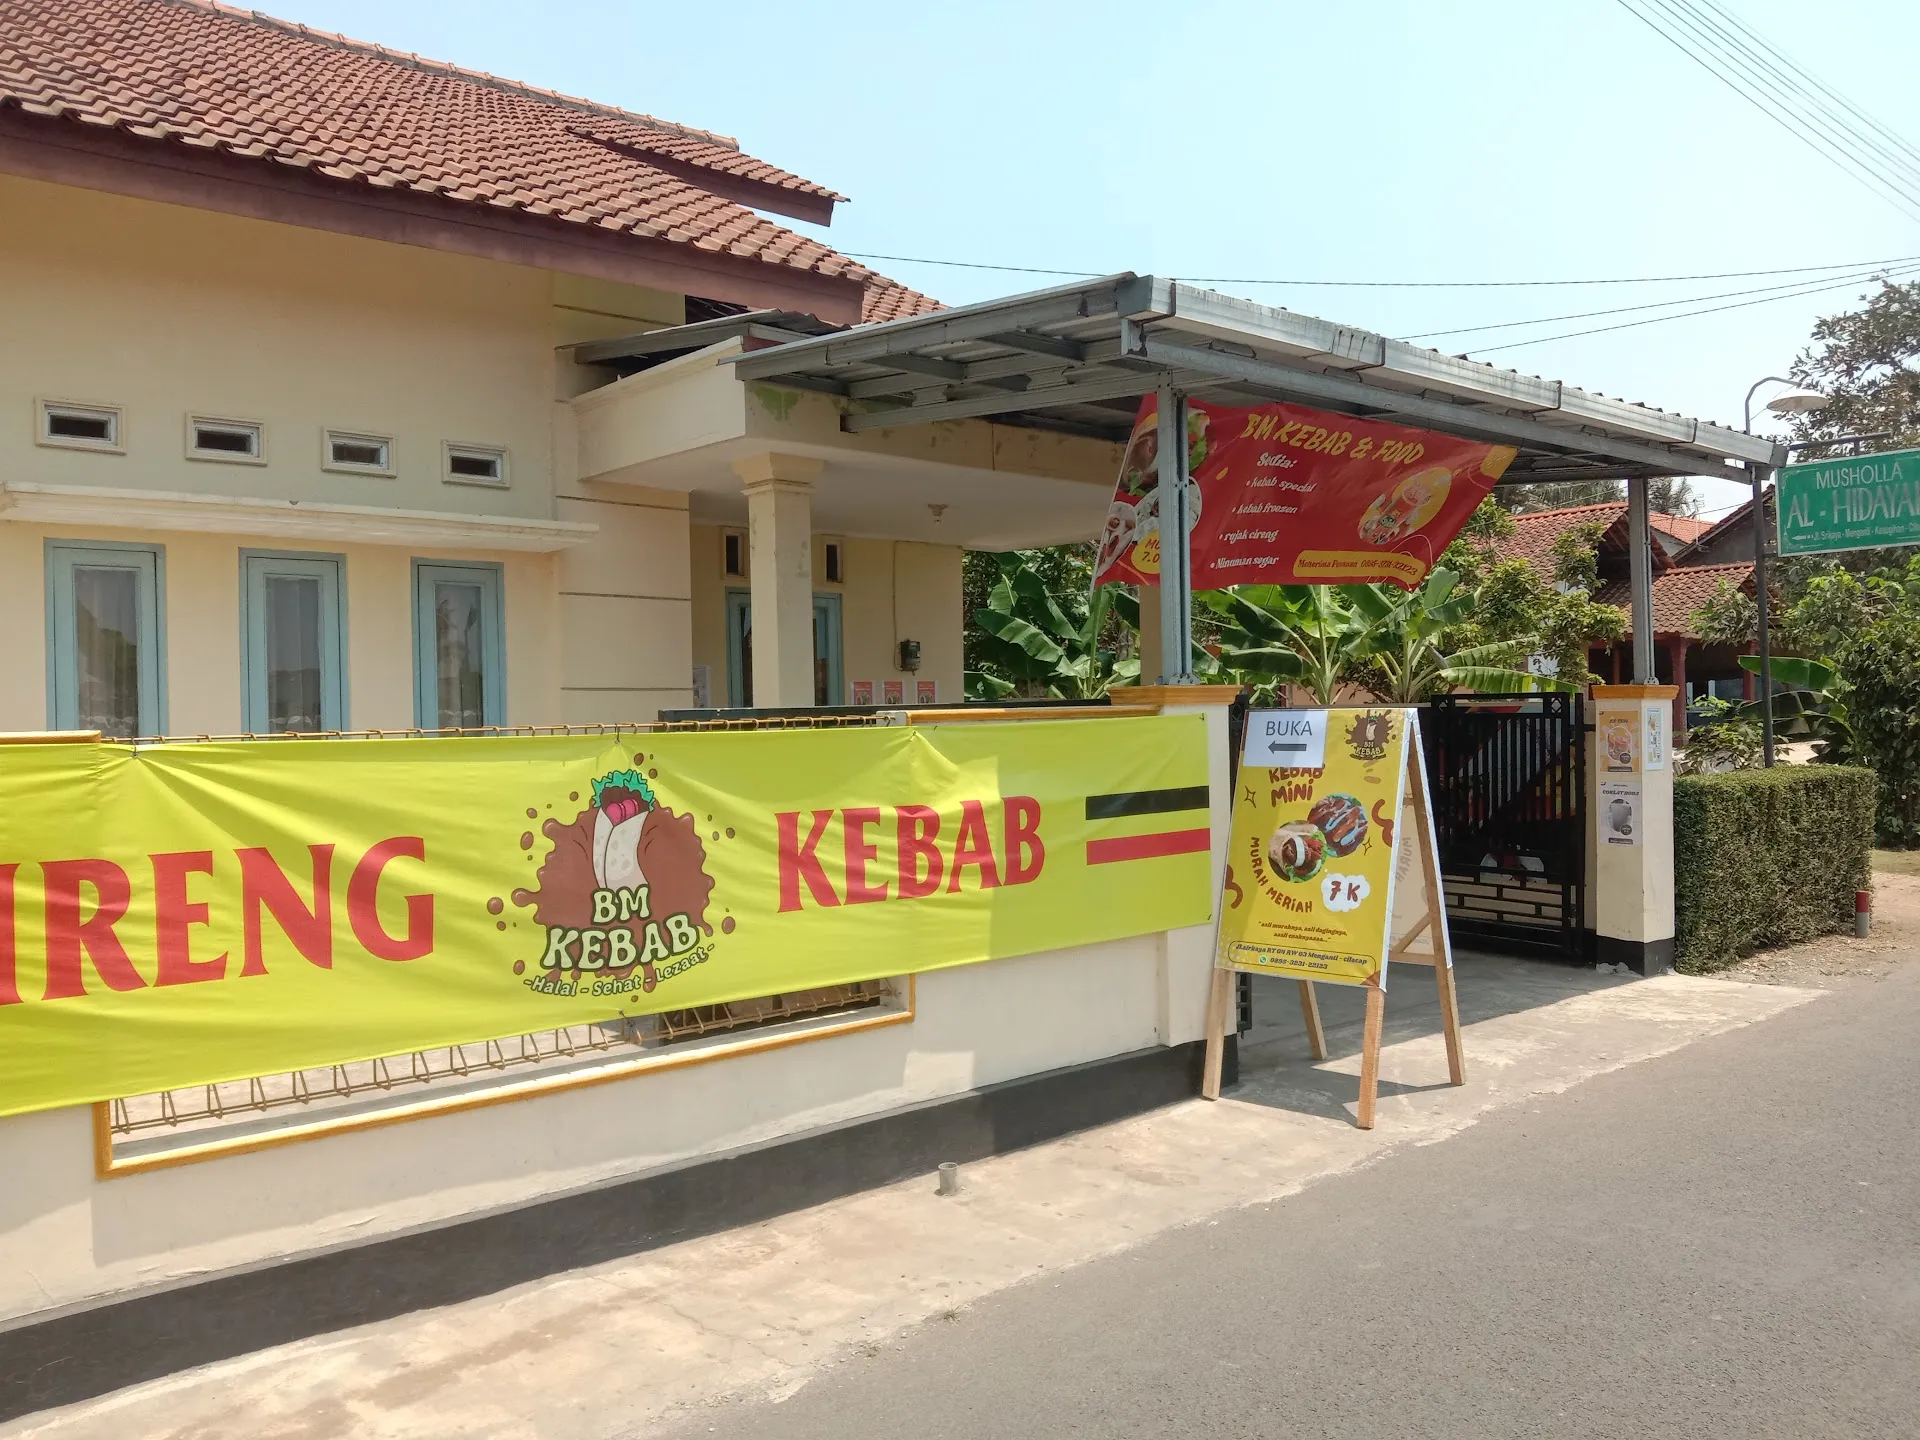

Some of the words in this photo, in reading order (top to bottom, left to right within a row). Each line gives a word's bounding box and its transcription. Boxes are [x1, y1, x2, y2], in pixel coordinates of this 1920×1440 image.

[1240, 413, 1279, 441] BM
[1272, 420, 1353, 456] KEBAB
[1349, 436, 1374, 459] &
[1371, 439, 1425, 465] FOOD
[1250, 476, 1278, 488] kebab
[1815, 461, 1904, 490] MUSHOLLA
[1236, 502, 1262, 515] kebab
[1786, 492, 1815, 529] AL
[1223, 529, 1249, 545] rujak
[1248, 528, 1280, 543] cireng
[1214, 557, 1253, 570] Minuman
[1252, 555, 1280, 569] segar
[1265, 720, 1313, 737] BUKA
[1268, 762, 1326, 784] KEBAB
[775, 795, 1046, 914] KEBAB
[1249, 836, 1269, 887] MURAH
[591, 884, 652, 925] BM
[1329, 880, 1342, 902] 7
[1346, 882, 1361, 903] K
[540, 912, 700, 971] KEBAB
[1285, 949, 1298, 957] RW
[592, 975, 642, 997] Sehat
[654, 946, 707, 983] Lezaat
